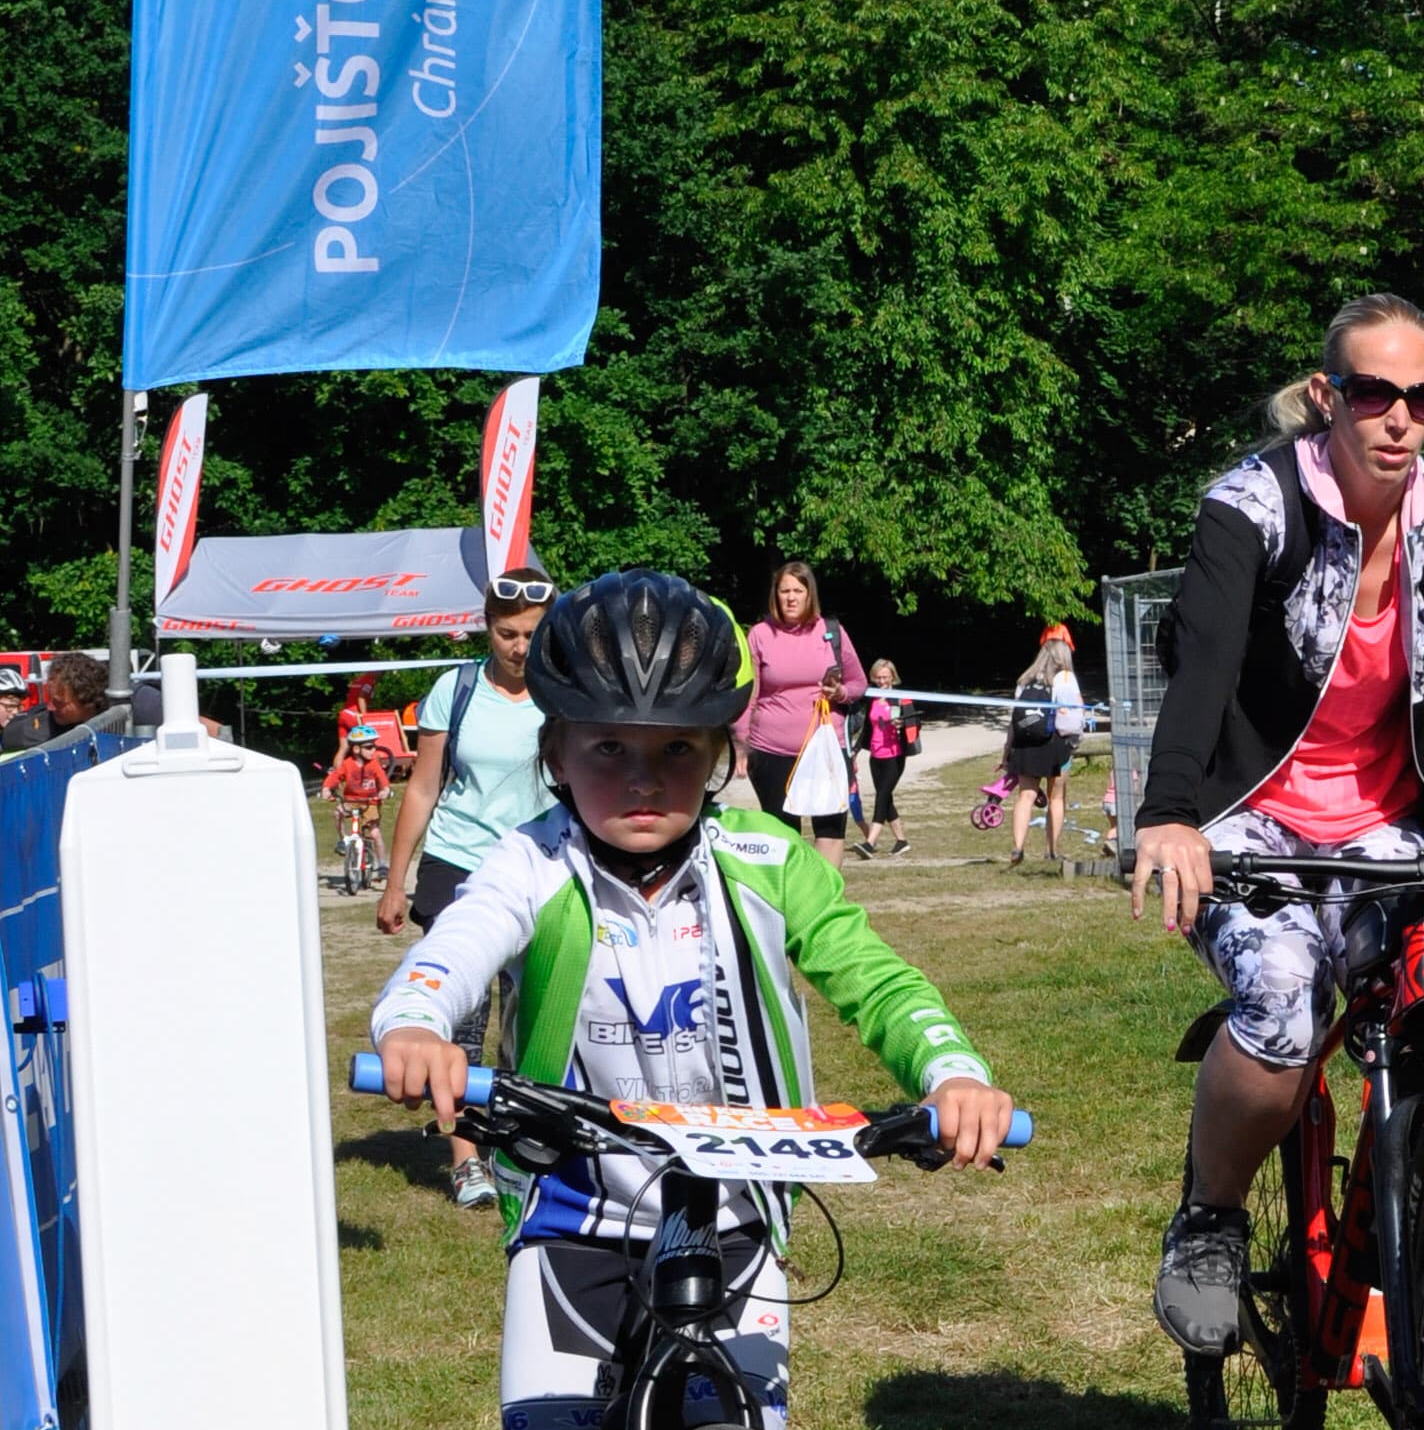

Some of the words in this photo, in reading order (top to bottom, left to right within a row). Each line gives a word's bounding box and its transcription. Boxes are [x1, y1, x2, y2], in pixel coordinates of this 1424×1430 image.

[490, 416, 522, 541] GHOST
[160, 430, 192, 554] GHOST
[251, 572, 429, 594] GHOST
[383, 588, 420, 598] TEAM
[162, 617, 240, 632] GHOST
[391, 611, 473, 629] GHOST
[685, 1132, 855, 1160] 2148
